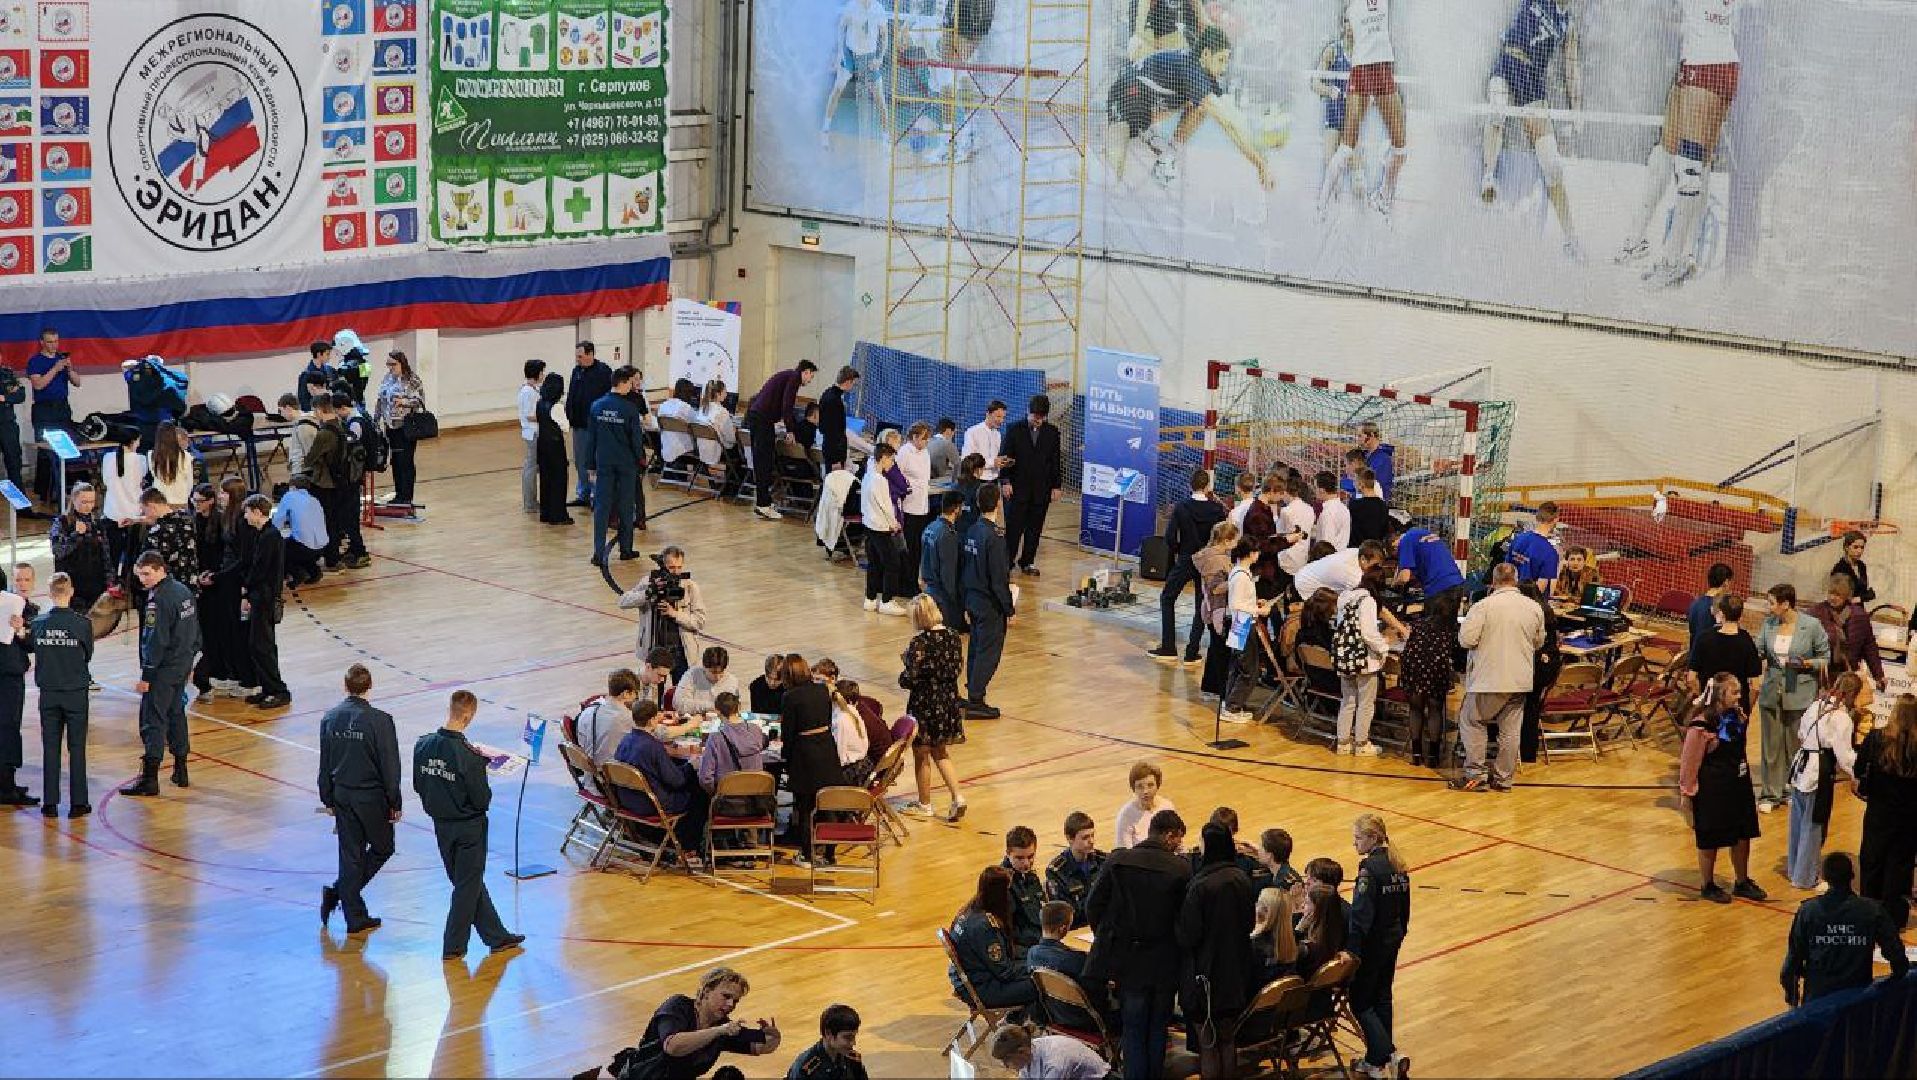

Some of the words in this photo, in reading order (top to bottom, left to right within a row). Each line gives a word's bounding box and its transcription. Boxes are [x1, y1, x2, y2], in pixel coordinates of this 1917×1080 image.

[139, 28, 280, 80] МЕЖРЕГИОНАЛЬНЫЙ
[578, 81, 587, 93] г.
[590, 79, 651, 95] Серпухов
[566, 117, 580, 131] +7
[566, 133, 580, 147] +7
[136, 175, 280, 247] ЭРИДАН
[1089, 386, 1123, 402] ПУТЬ
[1089, 401, 1154, 421] НАВЫКОВ
[1826, 924, 1855, 934] МЧС
[1815, 935, 1867, 946] РОССИИ
